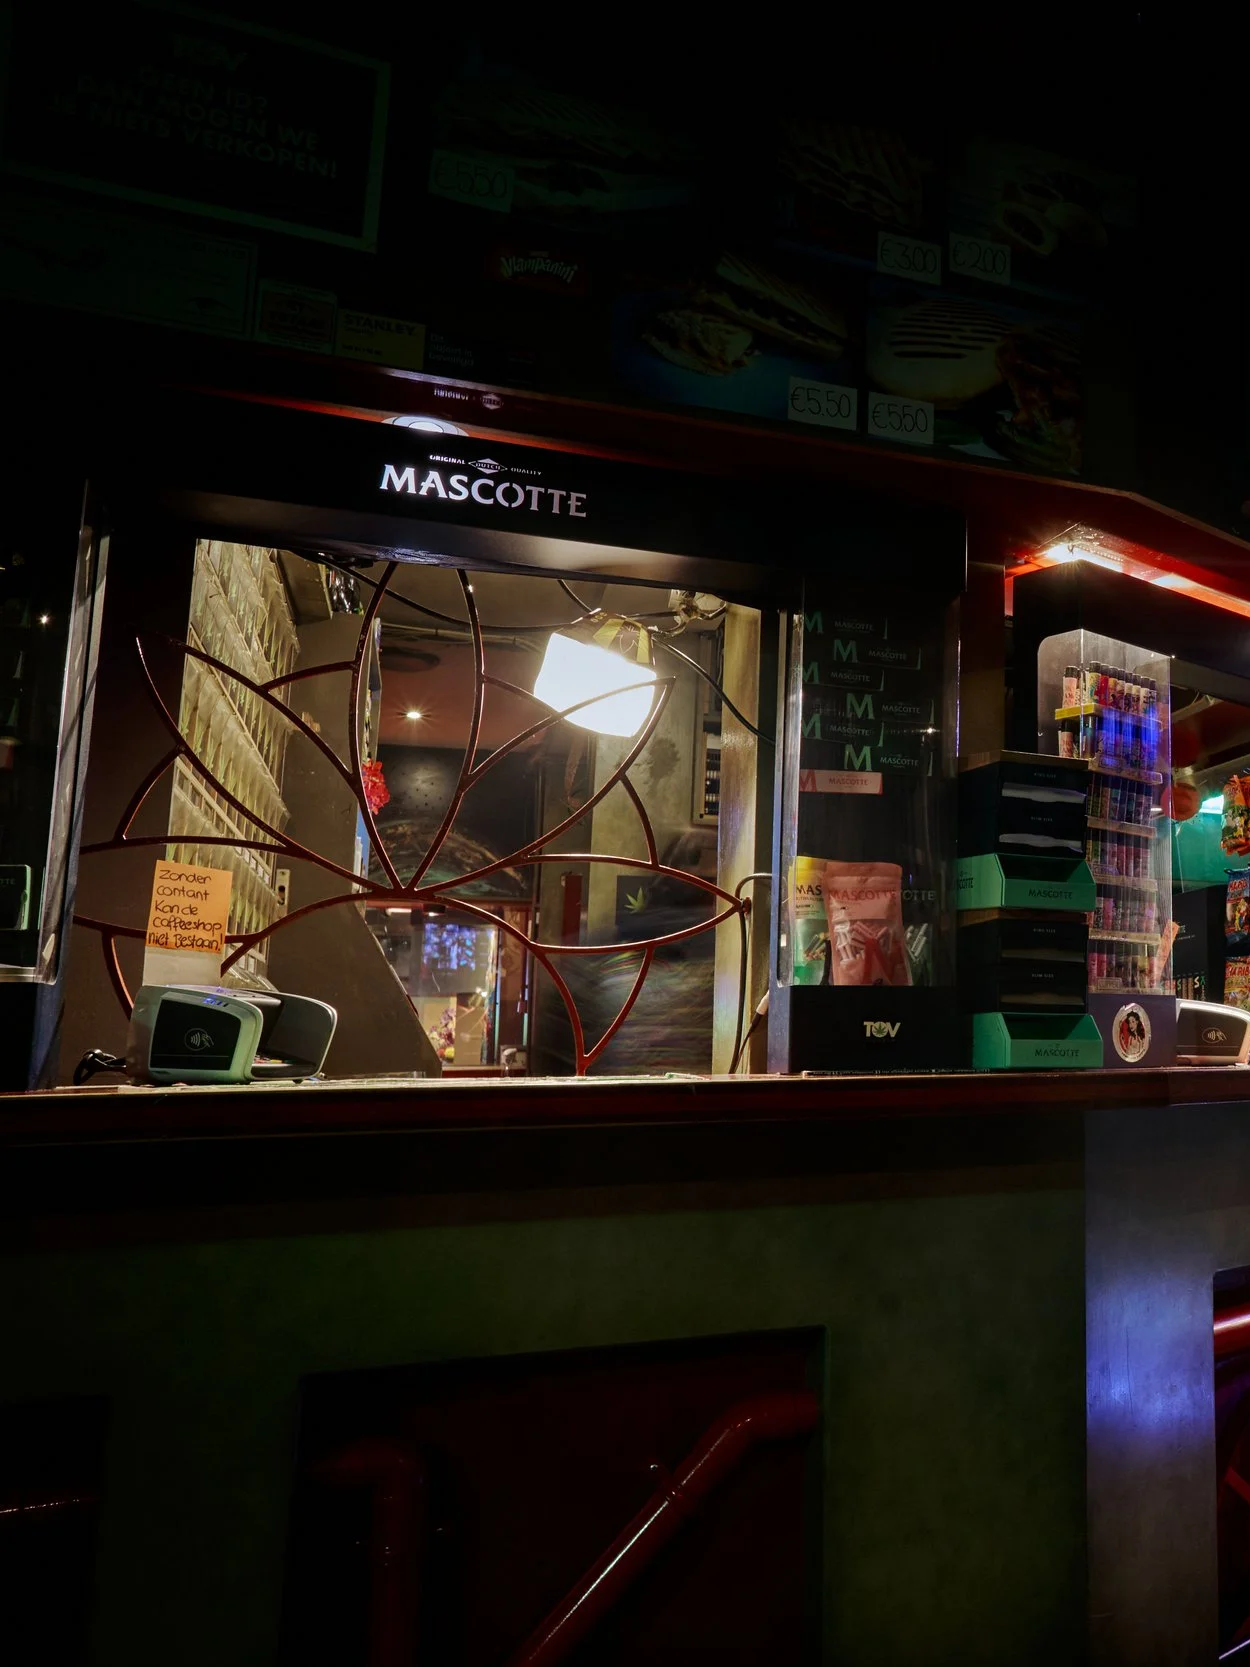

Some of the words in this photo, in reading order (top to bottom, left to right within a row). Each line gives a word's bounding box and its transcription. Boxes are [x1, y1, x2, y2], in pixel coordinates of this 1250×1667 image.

[160, 95, 267, 140] MOGEN
[276, 121, 320, 152] WE
[89, 100, 171, 139] NIETS
[181, 126, 339, 178] VERKOPEN!
[344, 313, 417, 336] STANLEY
[790, 386, 851, 418] €5.50
[429, 454, 466, 465] ORIGINAL
[510, 467, 542, 476] QUALITY
[379, 464, 587, 518] MASCOTTE
[834, 620, 875, 632] MASCOTTE
[833, 639, 859, 664] M
[868, 649, 908, 661] MASCOTTE
[830, 671, 871, 683] MASCOTTE
[845, 692, 875, 720] M
[881, 704, 921, 714] MASCOTTE
[829, 724, 871, 736] MASCOTTE
[844, 743, 873, 772] M
[880, 756, 920, 767] MASCOTTE
[828, 777, 869, 786] MASCOTTE
[159, 869, 212, 884] Zonder
[828, 889, 897, 902] MASCOTTE
[1028, 888, 1073, 900] MASCOTTE
[181, 904, 198, 916] de
[148, 932, 169, 946] niet
[863, 1020, 902, 1038] TOV
[1034, 1048, 1080, 1058] MASCOTTE
